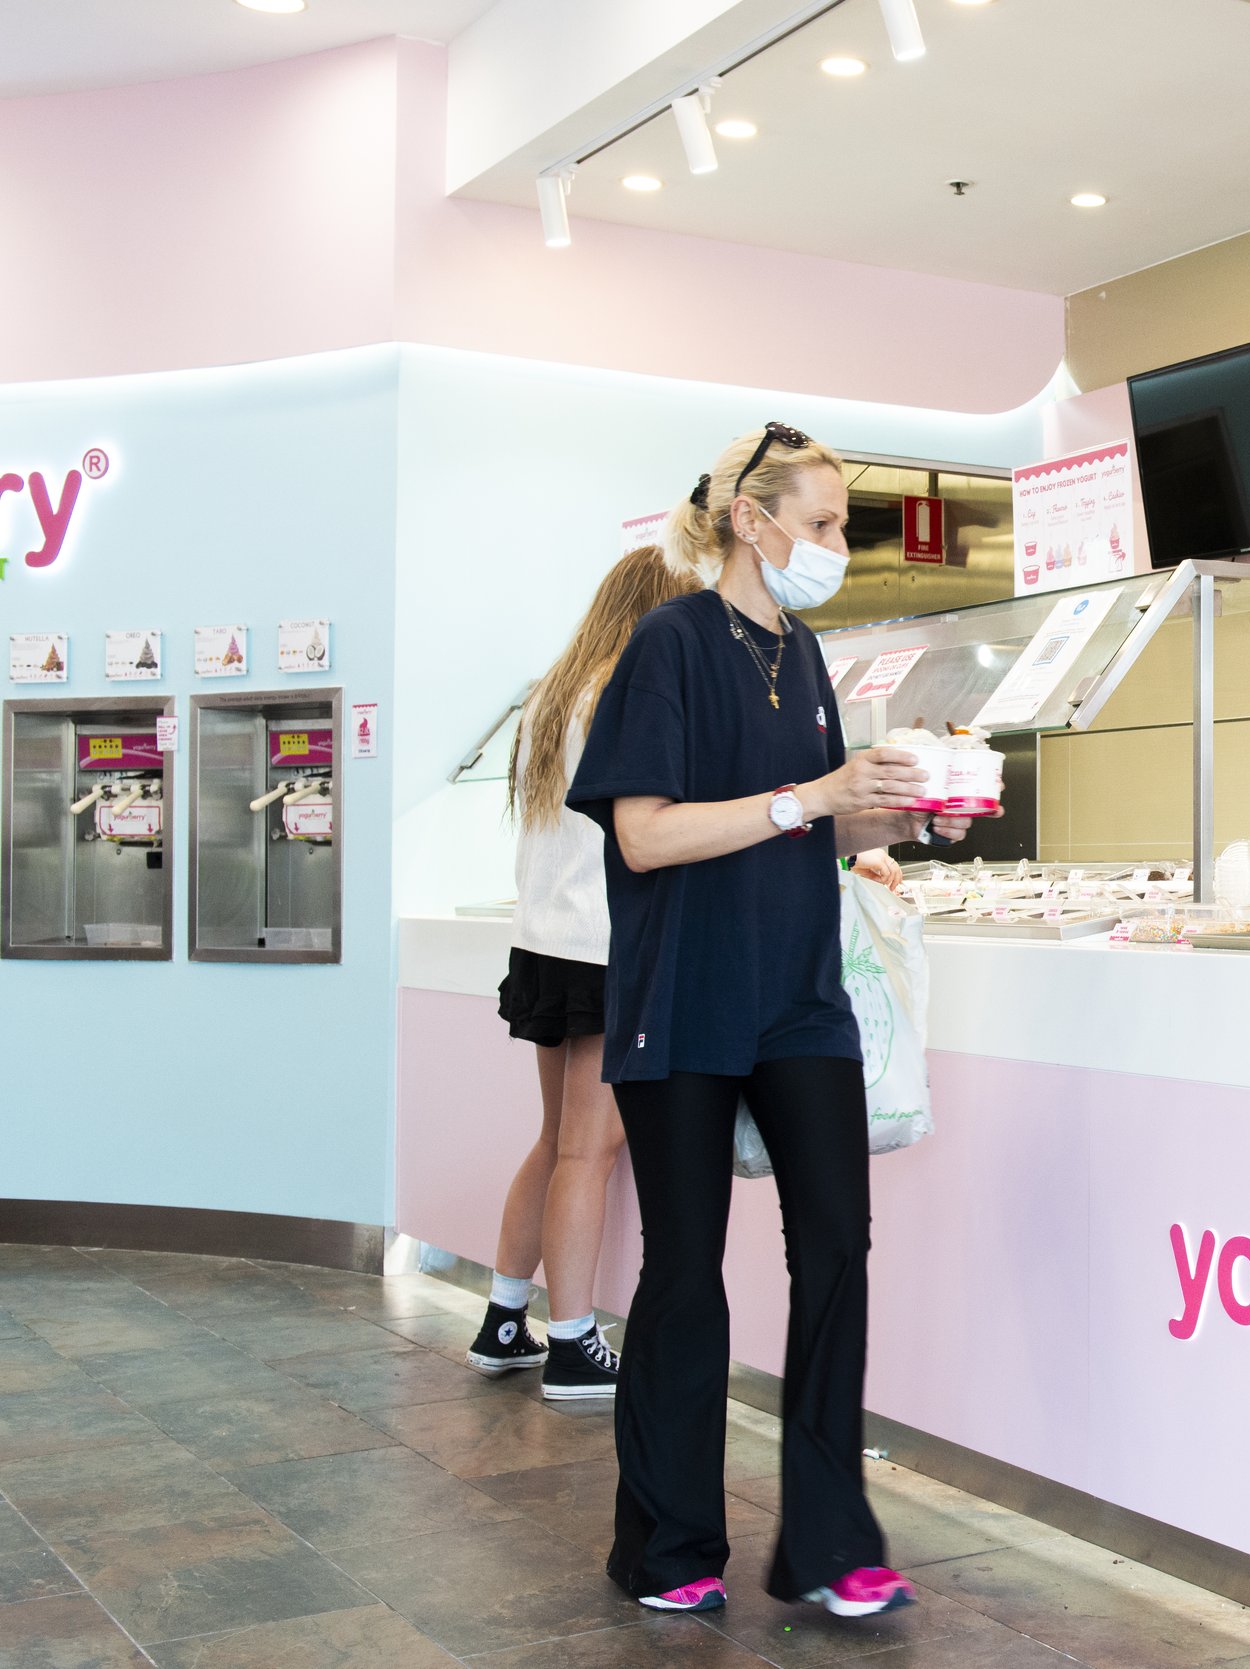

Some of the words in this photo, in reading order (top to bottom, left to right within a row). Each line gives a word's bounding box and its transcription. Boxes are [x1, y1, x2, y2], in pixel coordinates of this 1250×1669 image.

[1019, 489, 1031, 497] HOW
[1040, 483, 1057, 493] ENJOY
[1057, 479, 1076, 489] FROZEN
[1077, 473, 1097, 484] YOGURT
[906, 552, 941, 560] EXTINGUISHER
